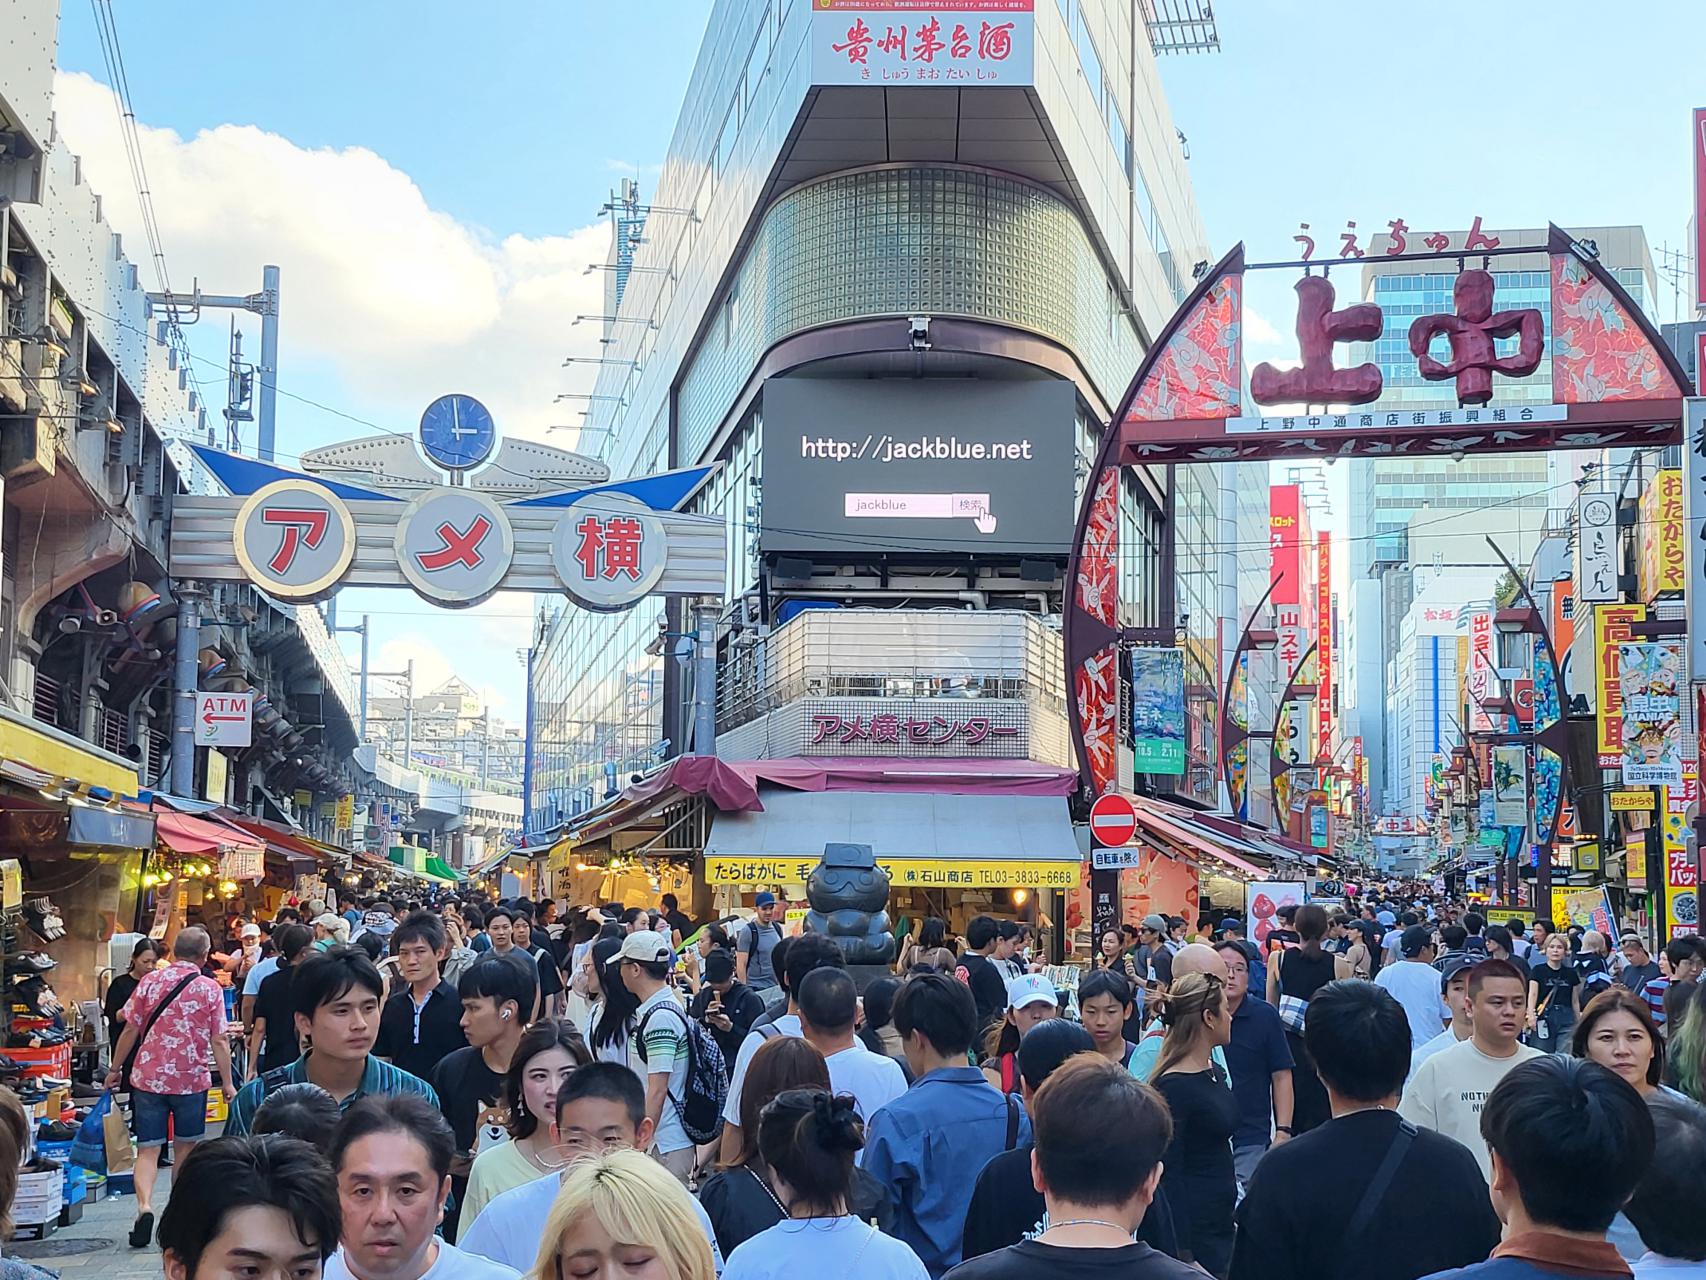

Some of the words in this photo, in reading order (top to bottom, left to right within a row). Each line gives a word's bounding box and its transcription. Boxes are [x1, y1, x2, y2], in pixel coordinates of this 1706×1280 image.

[832, 16, 1015, 64] 貴州茅台酒
[1294, 216, 1501, 260] うえちゅん
[1250, 268, 1544, 407] 上中
[1256, 408, 1535, 431] 上野中通商店街振興組合
[801, 434, 1033, 462] http://jackblue.net
[855, 498, 907, 513] jackblue
[262, 506, 644, 583] アメ横
[1662, 475, 1684, 587] おたからや
[1424, 608, 1460, 622] 松坂
[203, 698, 247, 712] ATM
[812, 714, 1018, 744] アメ横センター
[1095, 852, 1137, 865] 自転車を除く
[714, 862, 786, 882] たらばがに
[980, 869, 1072, 884] TEL03-3833-6668
